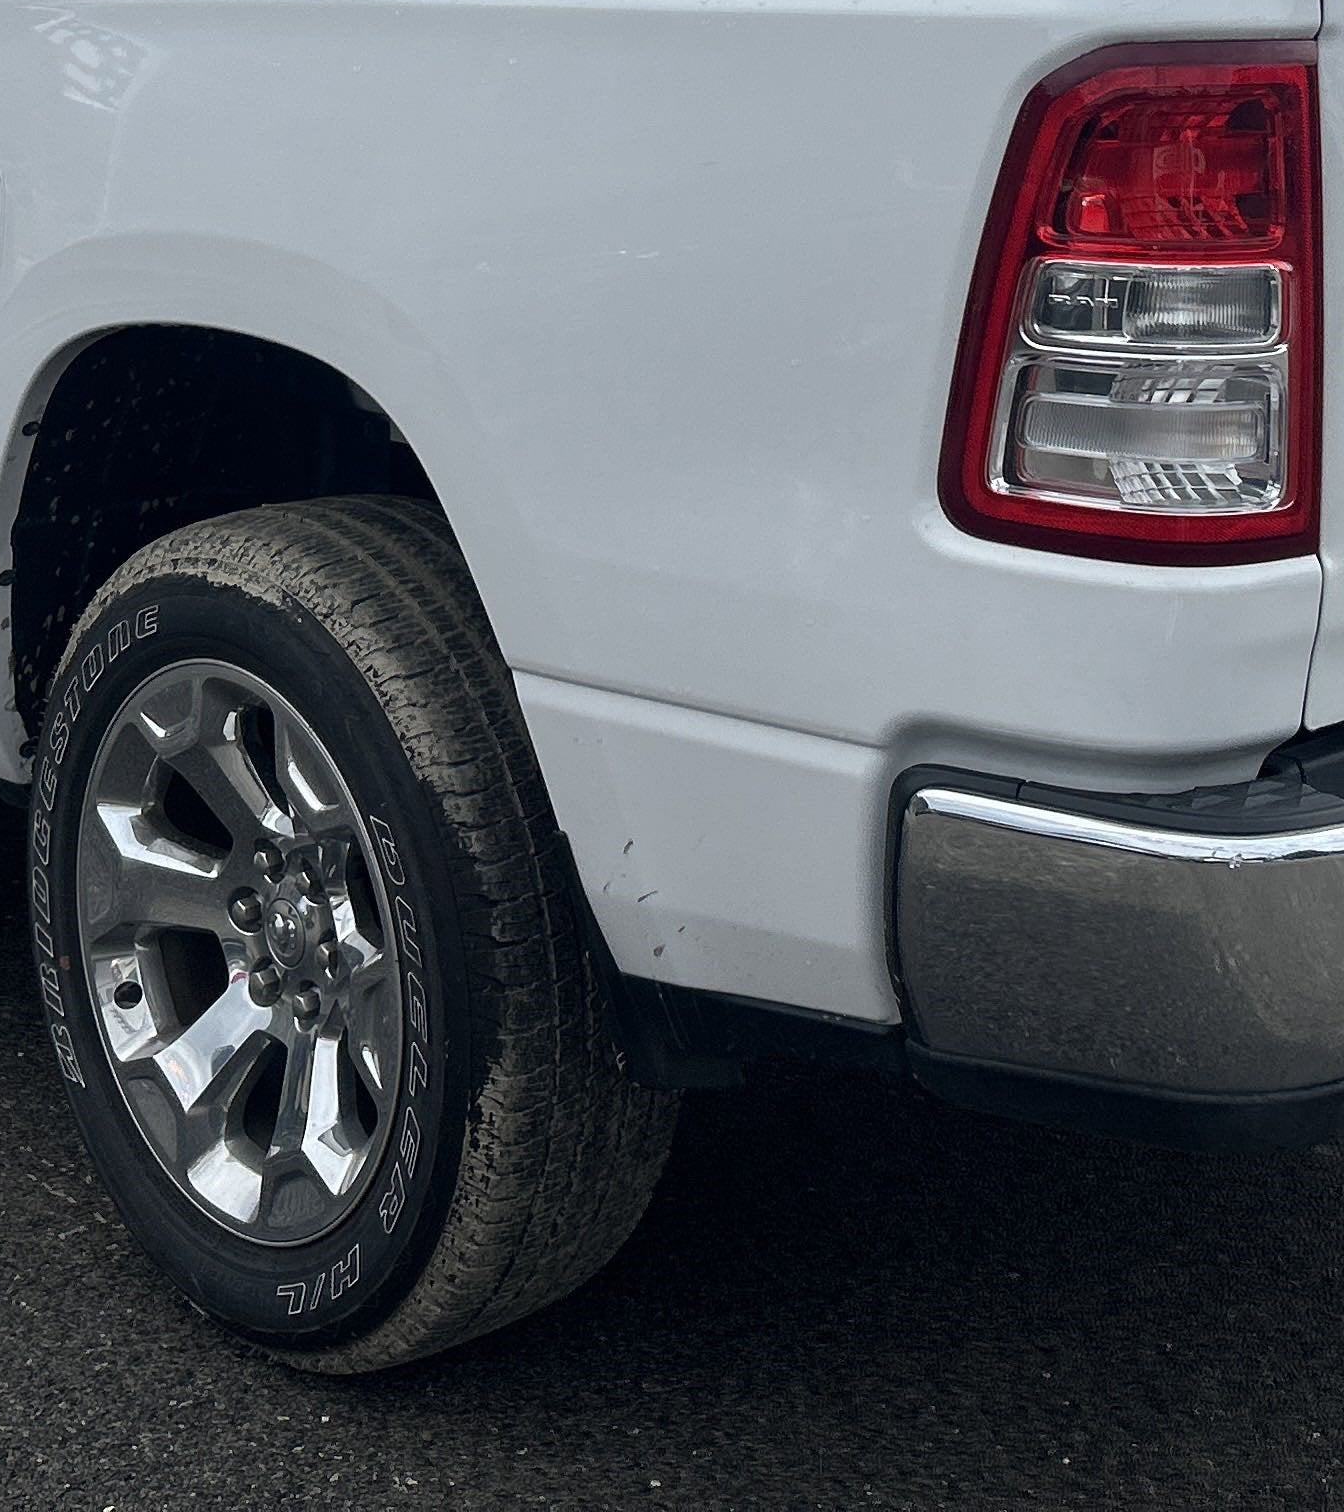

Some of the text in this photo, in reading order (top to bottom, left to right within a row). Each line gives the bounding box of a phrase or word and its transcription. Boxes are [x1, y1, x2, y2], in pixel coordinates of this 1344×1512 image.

[32, 604, 159, 1089] BRIDGESTONE
[277, 815, 428, 1316] DUELER H/L
